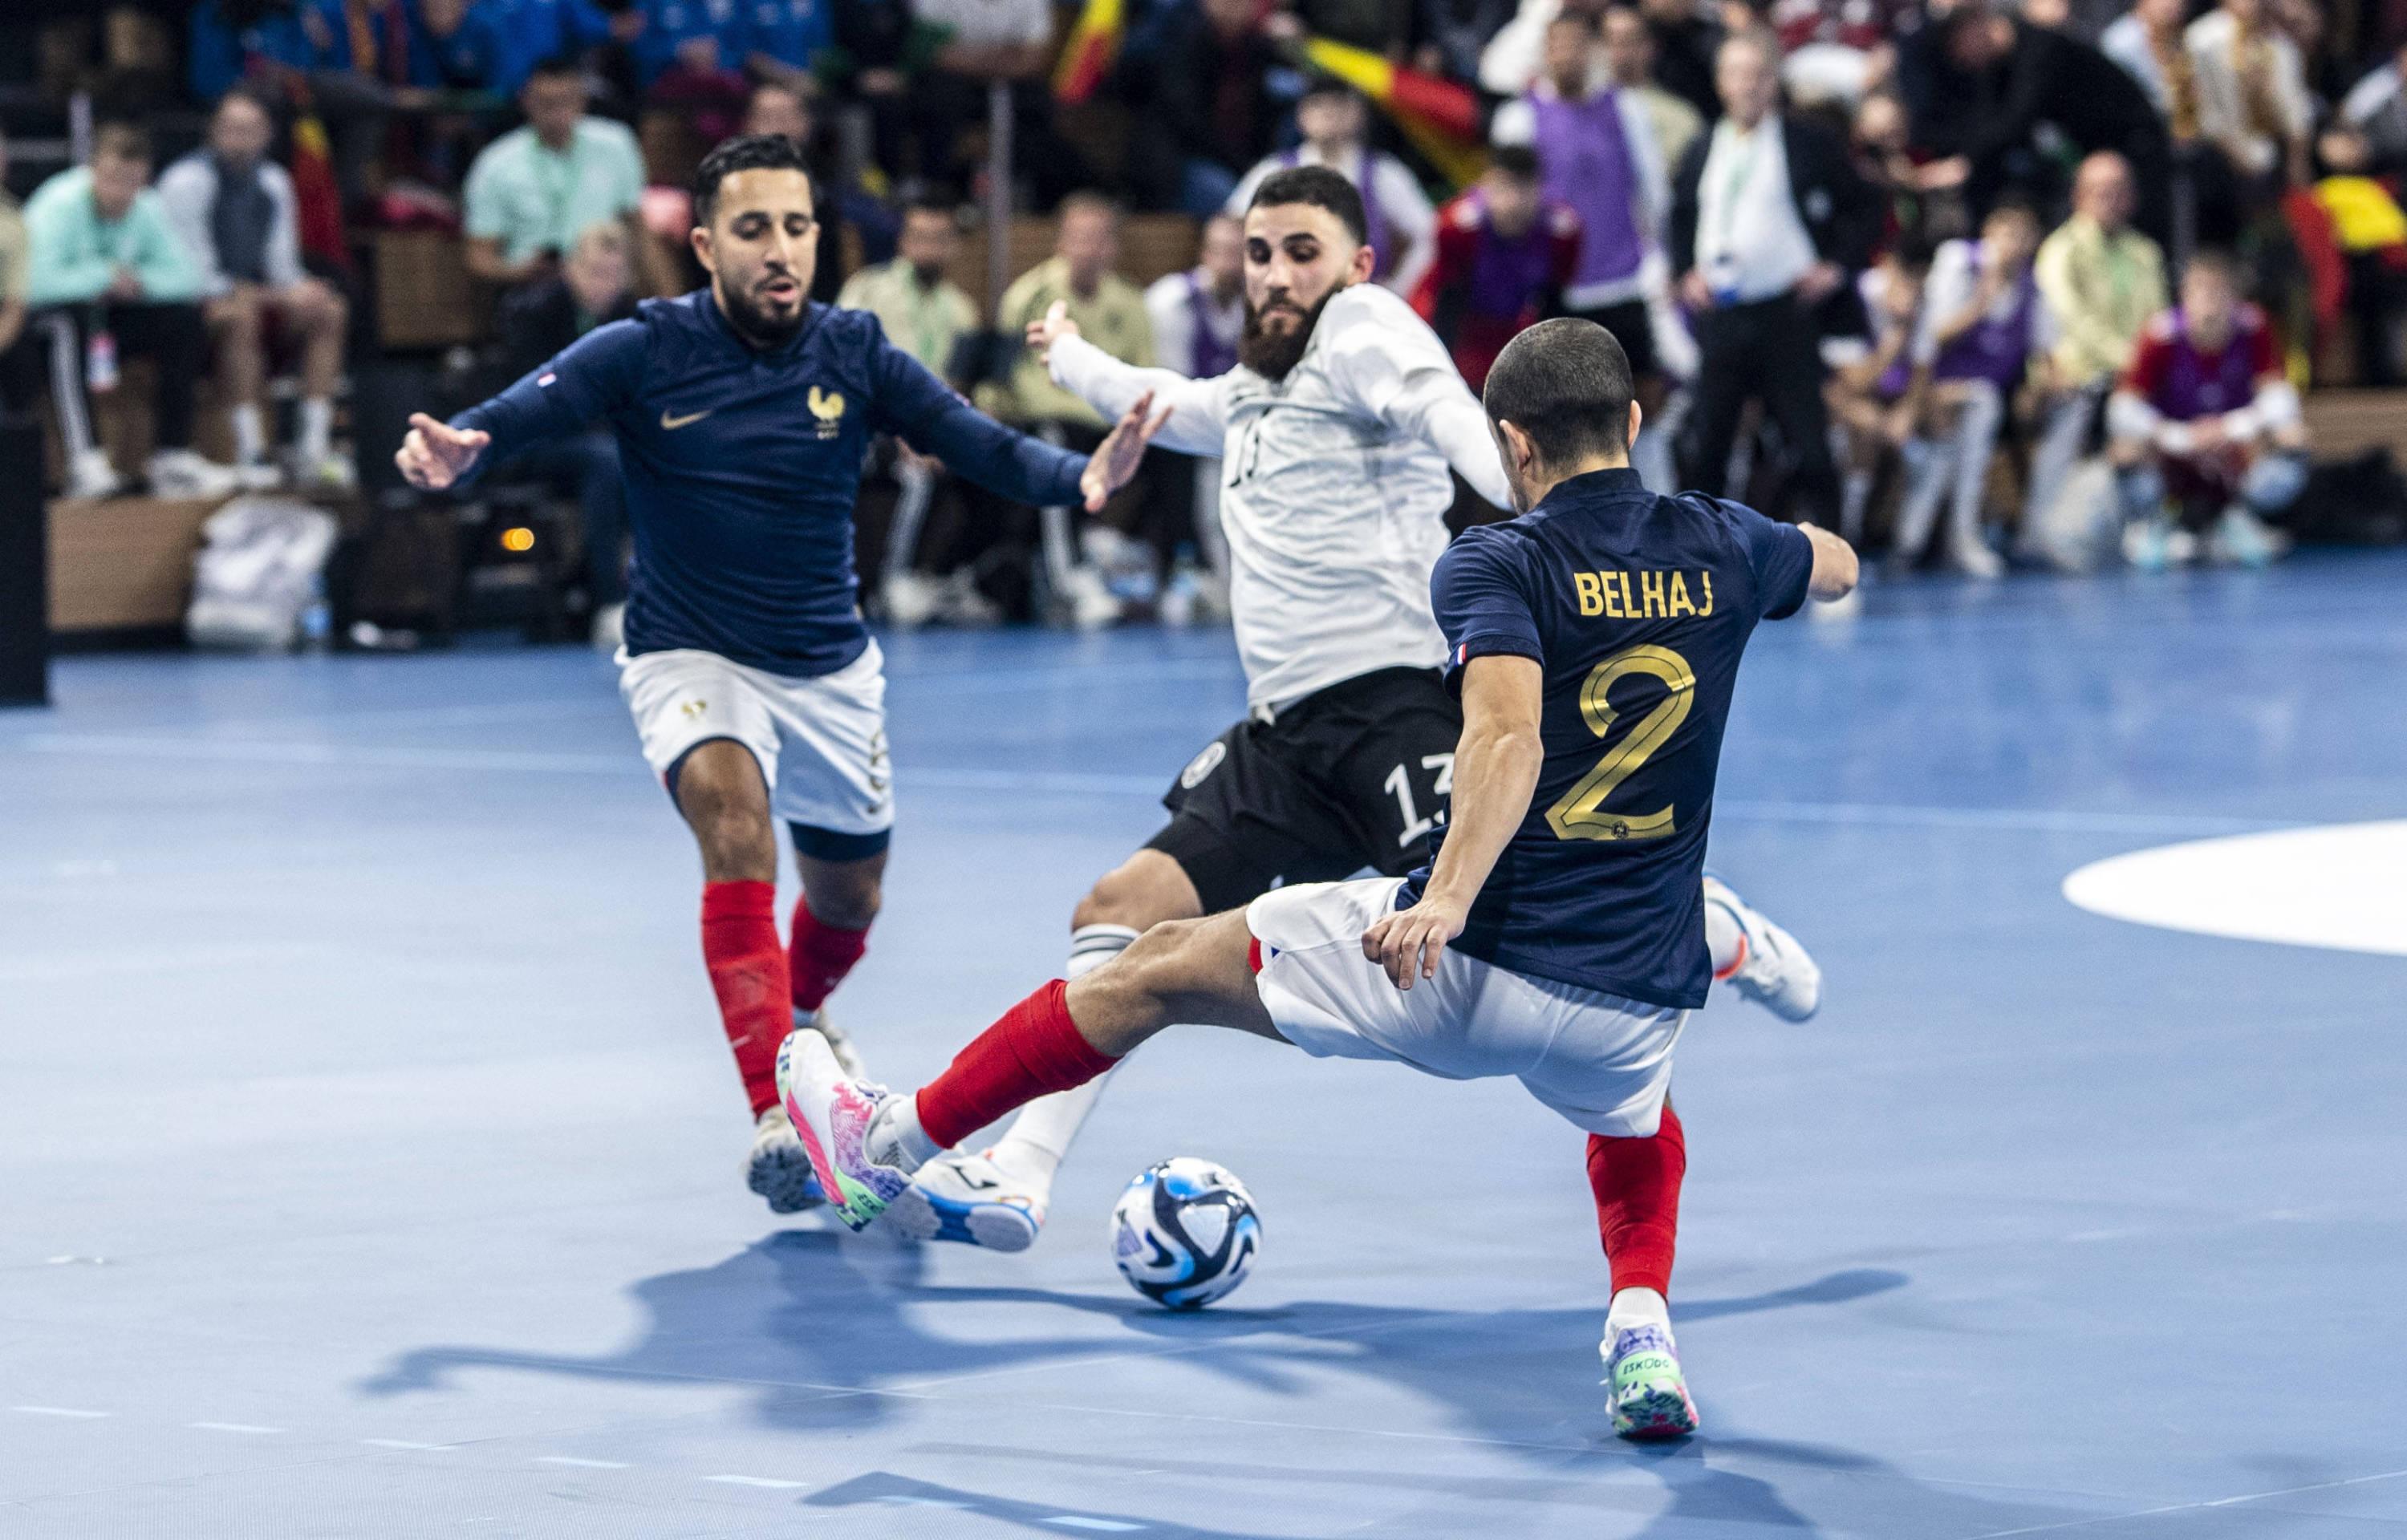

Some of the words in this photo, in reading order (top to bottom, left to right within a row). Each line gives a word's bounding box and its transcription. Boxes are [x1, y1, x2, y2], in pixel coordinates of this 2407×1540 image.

[1573, 570, 1713, 618] BELHAJ
[1544, 644, 1696, 841] 2
[1384, 752, 1455, 848] 13
